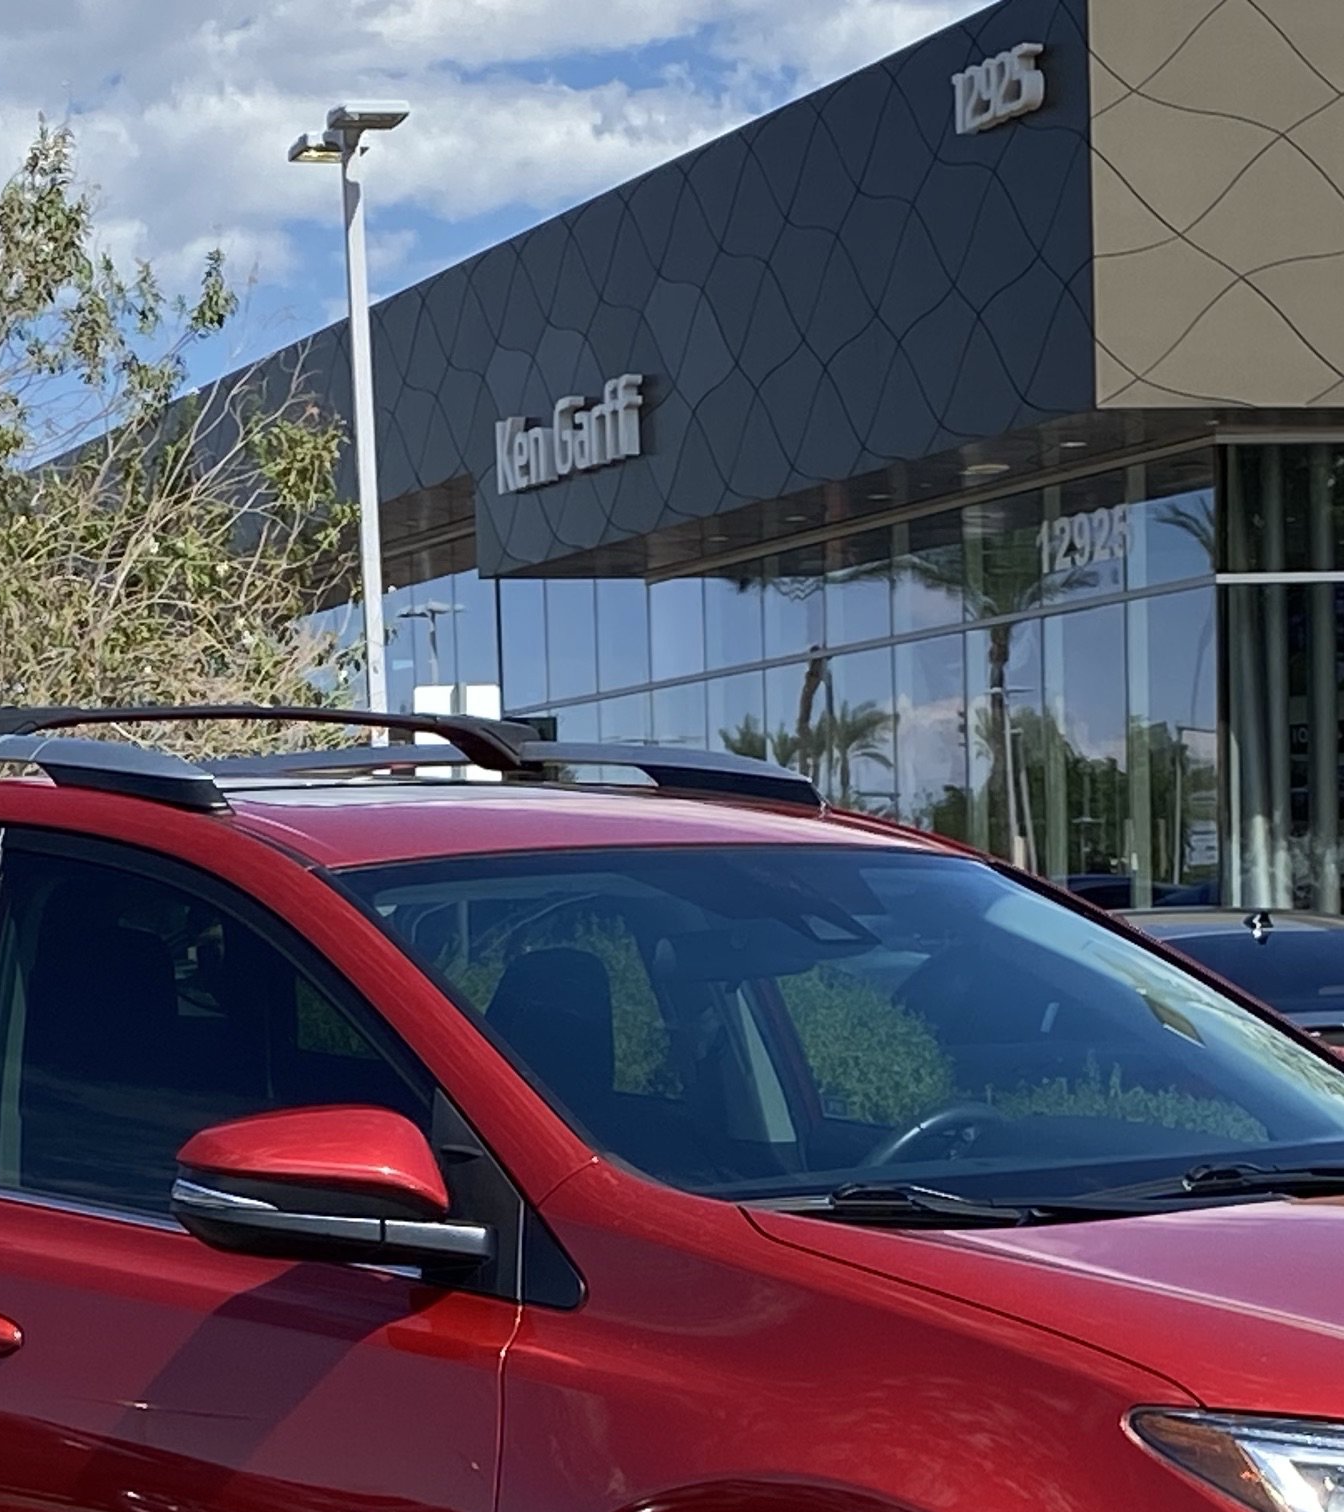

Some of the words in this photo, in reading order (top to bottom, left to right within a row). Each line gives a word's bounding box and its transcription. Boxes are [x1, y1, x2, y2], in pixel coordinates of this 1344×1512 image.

[952, 42, 1044, 134] 12925
[495, 416, 558, 495] Ken
[554, 373, 644, 475] Garff
[1036, 504, 1134, 574] 12925
